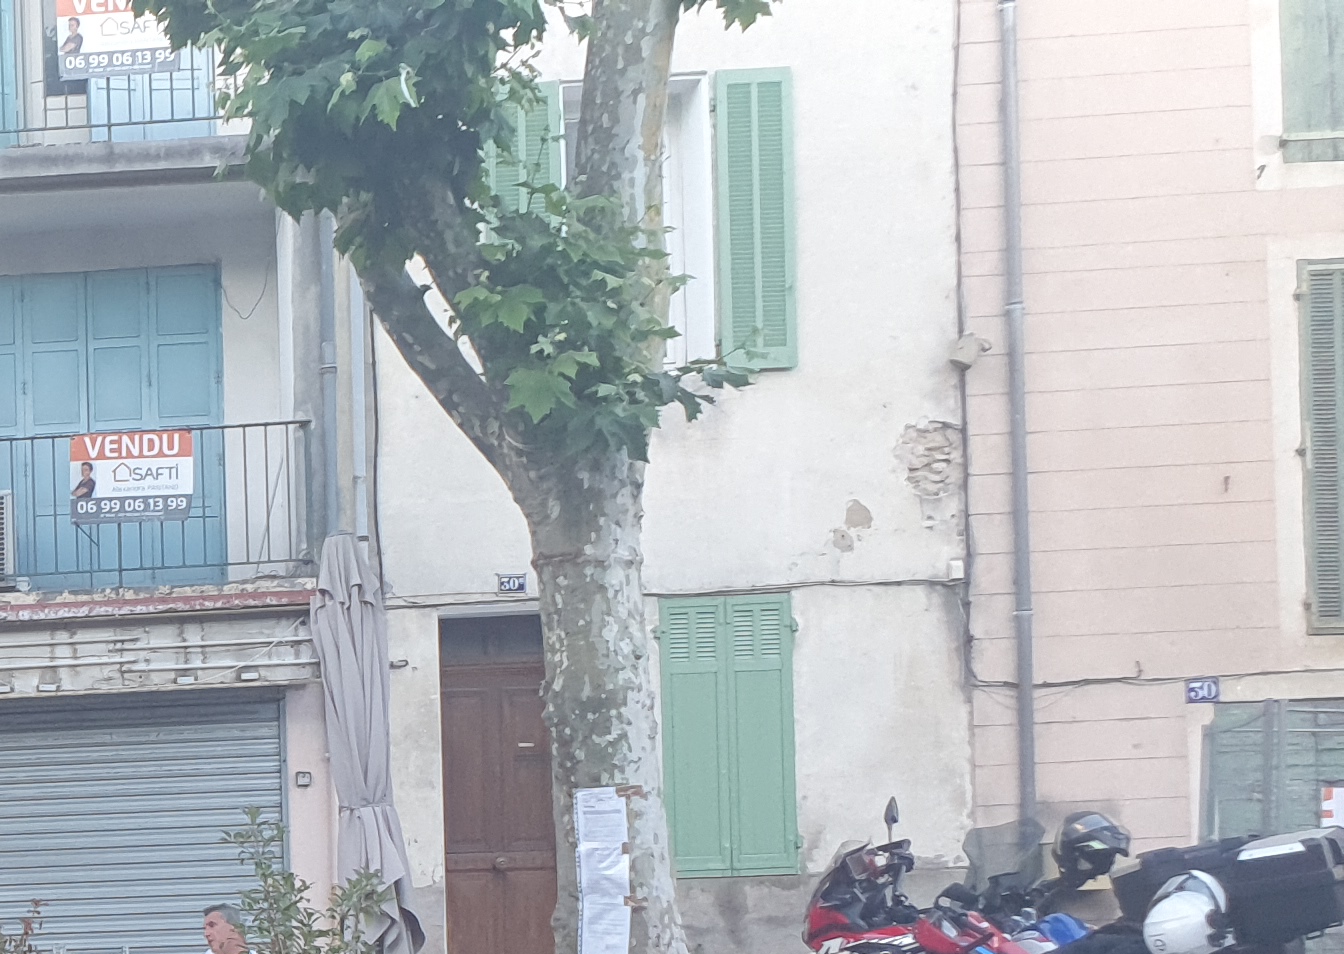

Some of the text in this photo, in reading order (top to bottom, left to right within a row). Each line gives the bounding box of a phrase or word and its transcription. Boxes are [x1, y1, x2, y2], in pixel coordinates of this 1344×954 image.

[65, 55, 86, 69] 06
[88, 53, 109, 67] 99
[112, 52, 133, 65] 06
[135, 50, 152, 64] 13
[155, 48, 175, 62] 99
[83, 432, 180, 459] VENDU
[77, 497, 188, 514] 06 99 06 13 99
[1188, 681, 1216, 700] 30
